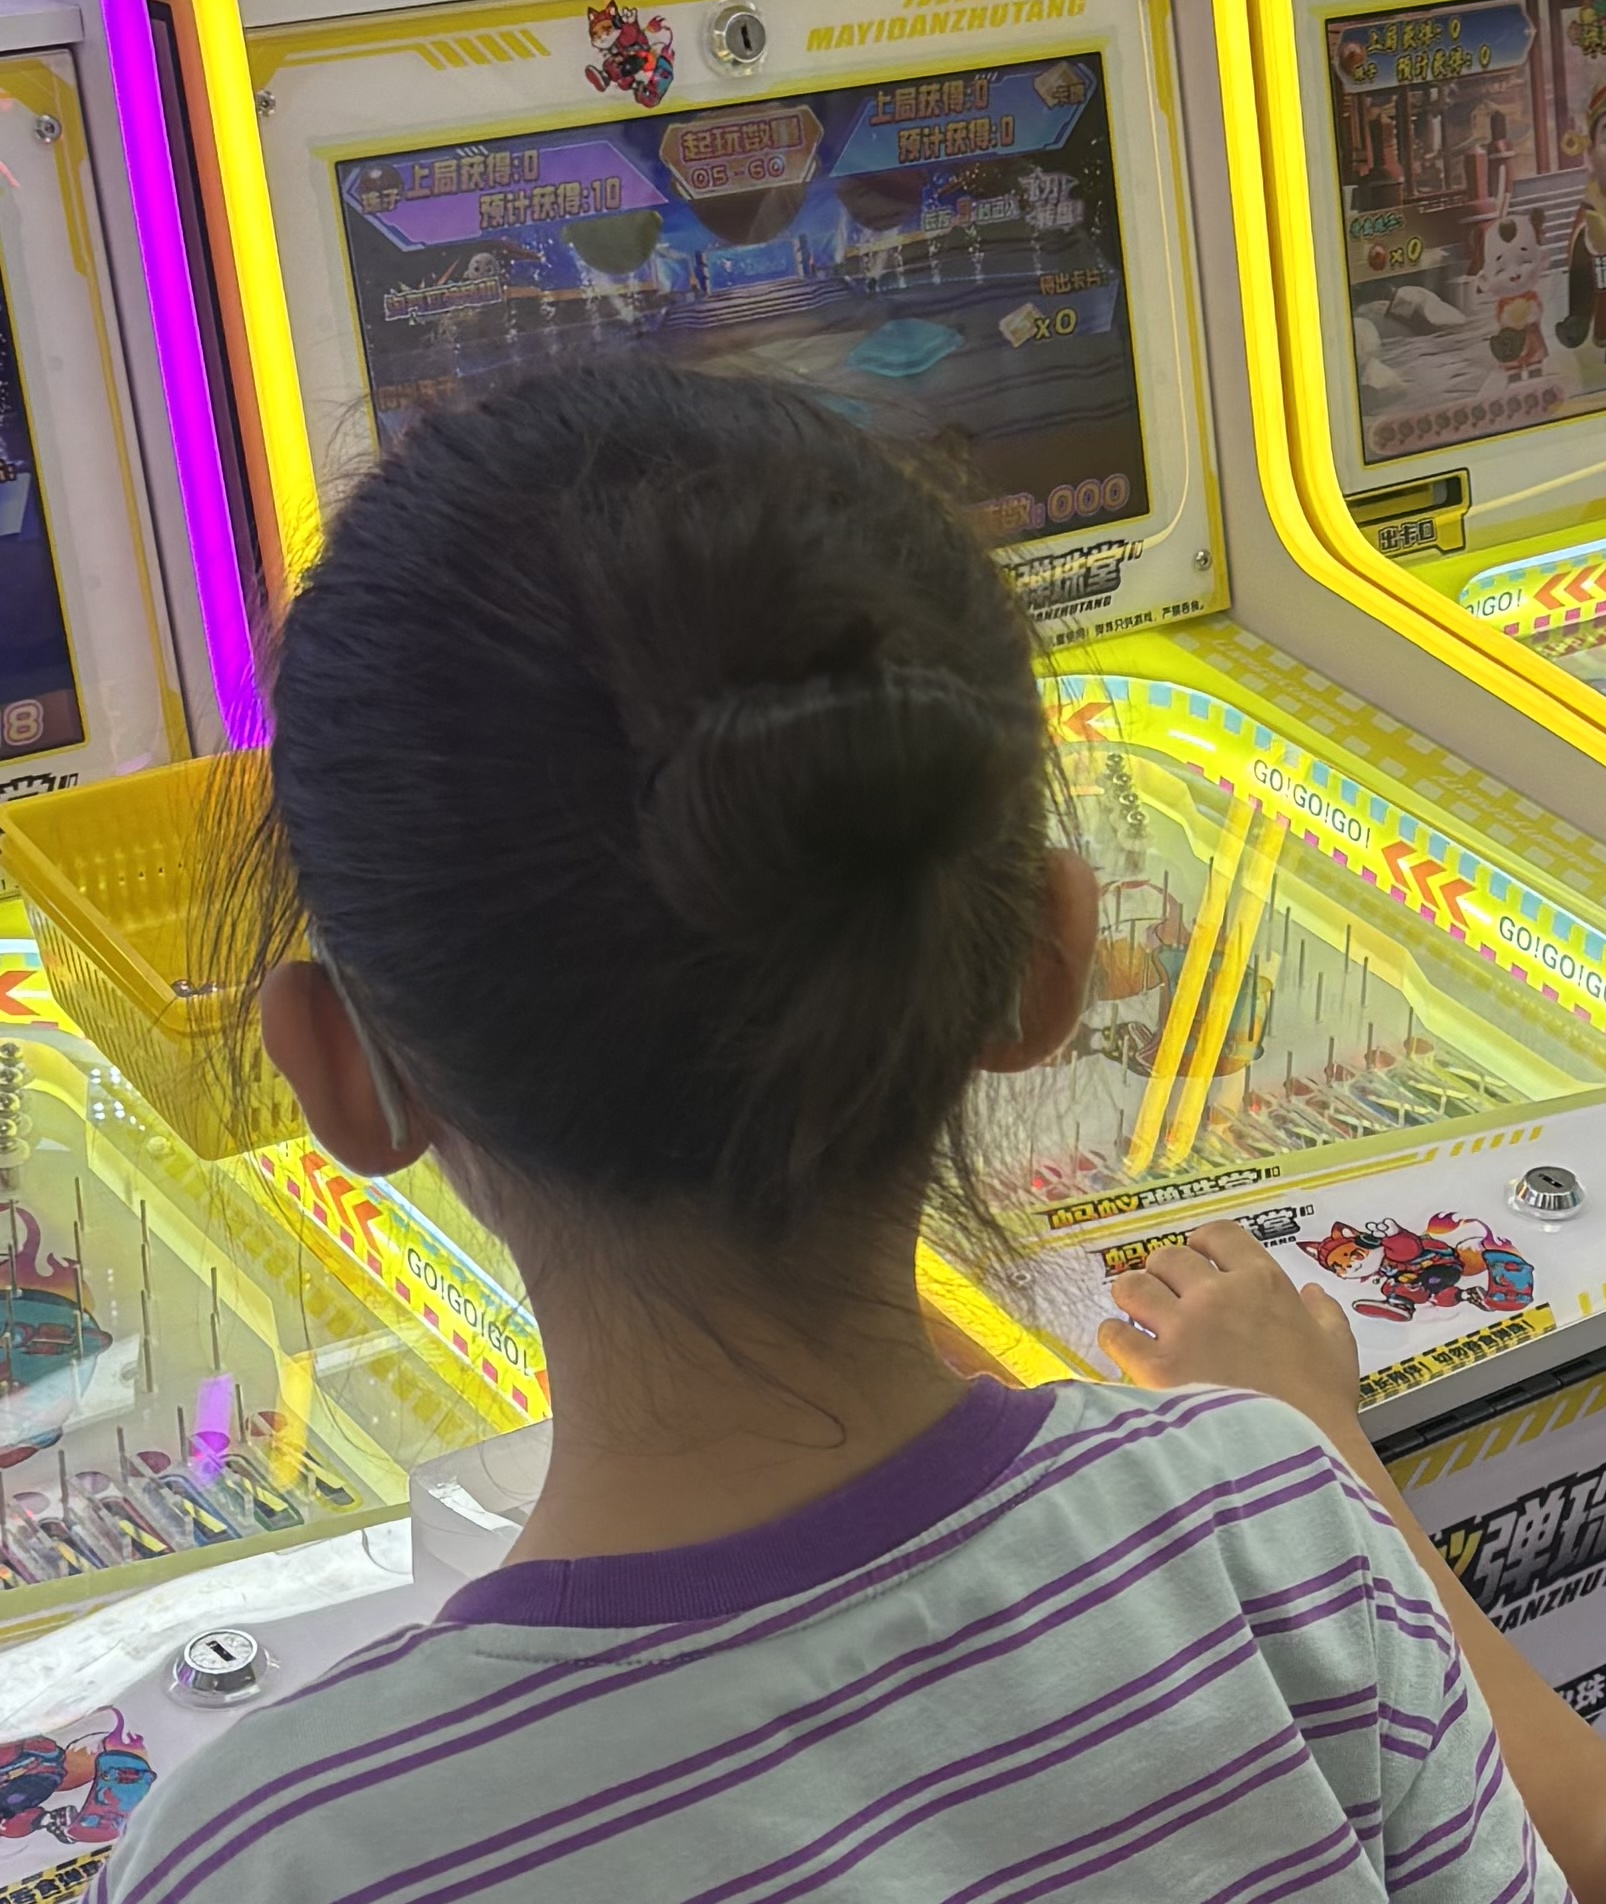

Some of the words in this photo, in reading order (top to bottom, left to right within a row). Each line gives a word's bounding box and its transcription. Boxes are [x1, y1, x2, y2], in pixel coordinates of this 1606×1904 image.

[869, 79, 991, 127] 上局获得:0
[681, 114, 804, 164] 起玩数量
[897, 116, 1016, 164] 预计获得:0
[405, 149, 540, 201] 上局获得:0
[478, 176, 622, 230] 预计获得:10
[1379, 518, 1436, 552] 出卡口
[7, 702, 41, 744] 8
[1252, 758, 1371, 850] GO!GO!GO!
[405, 1242, 532, 1377] GO!GO!GO!
